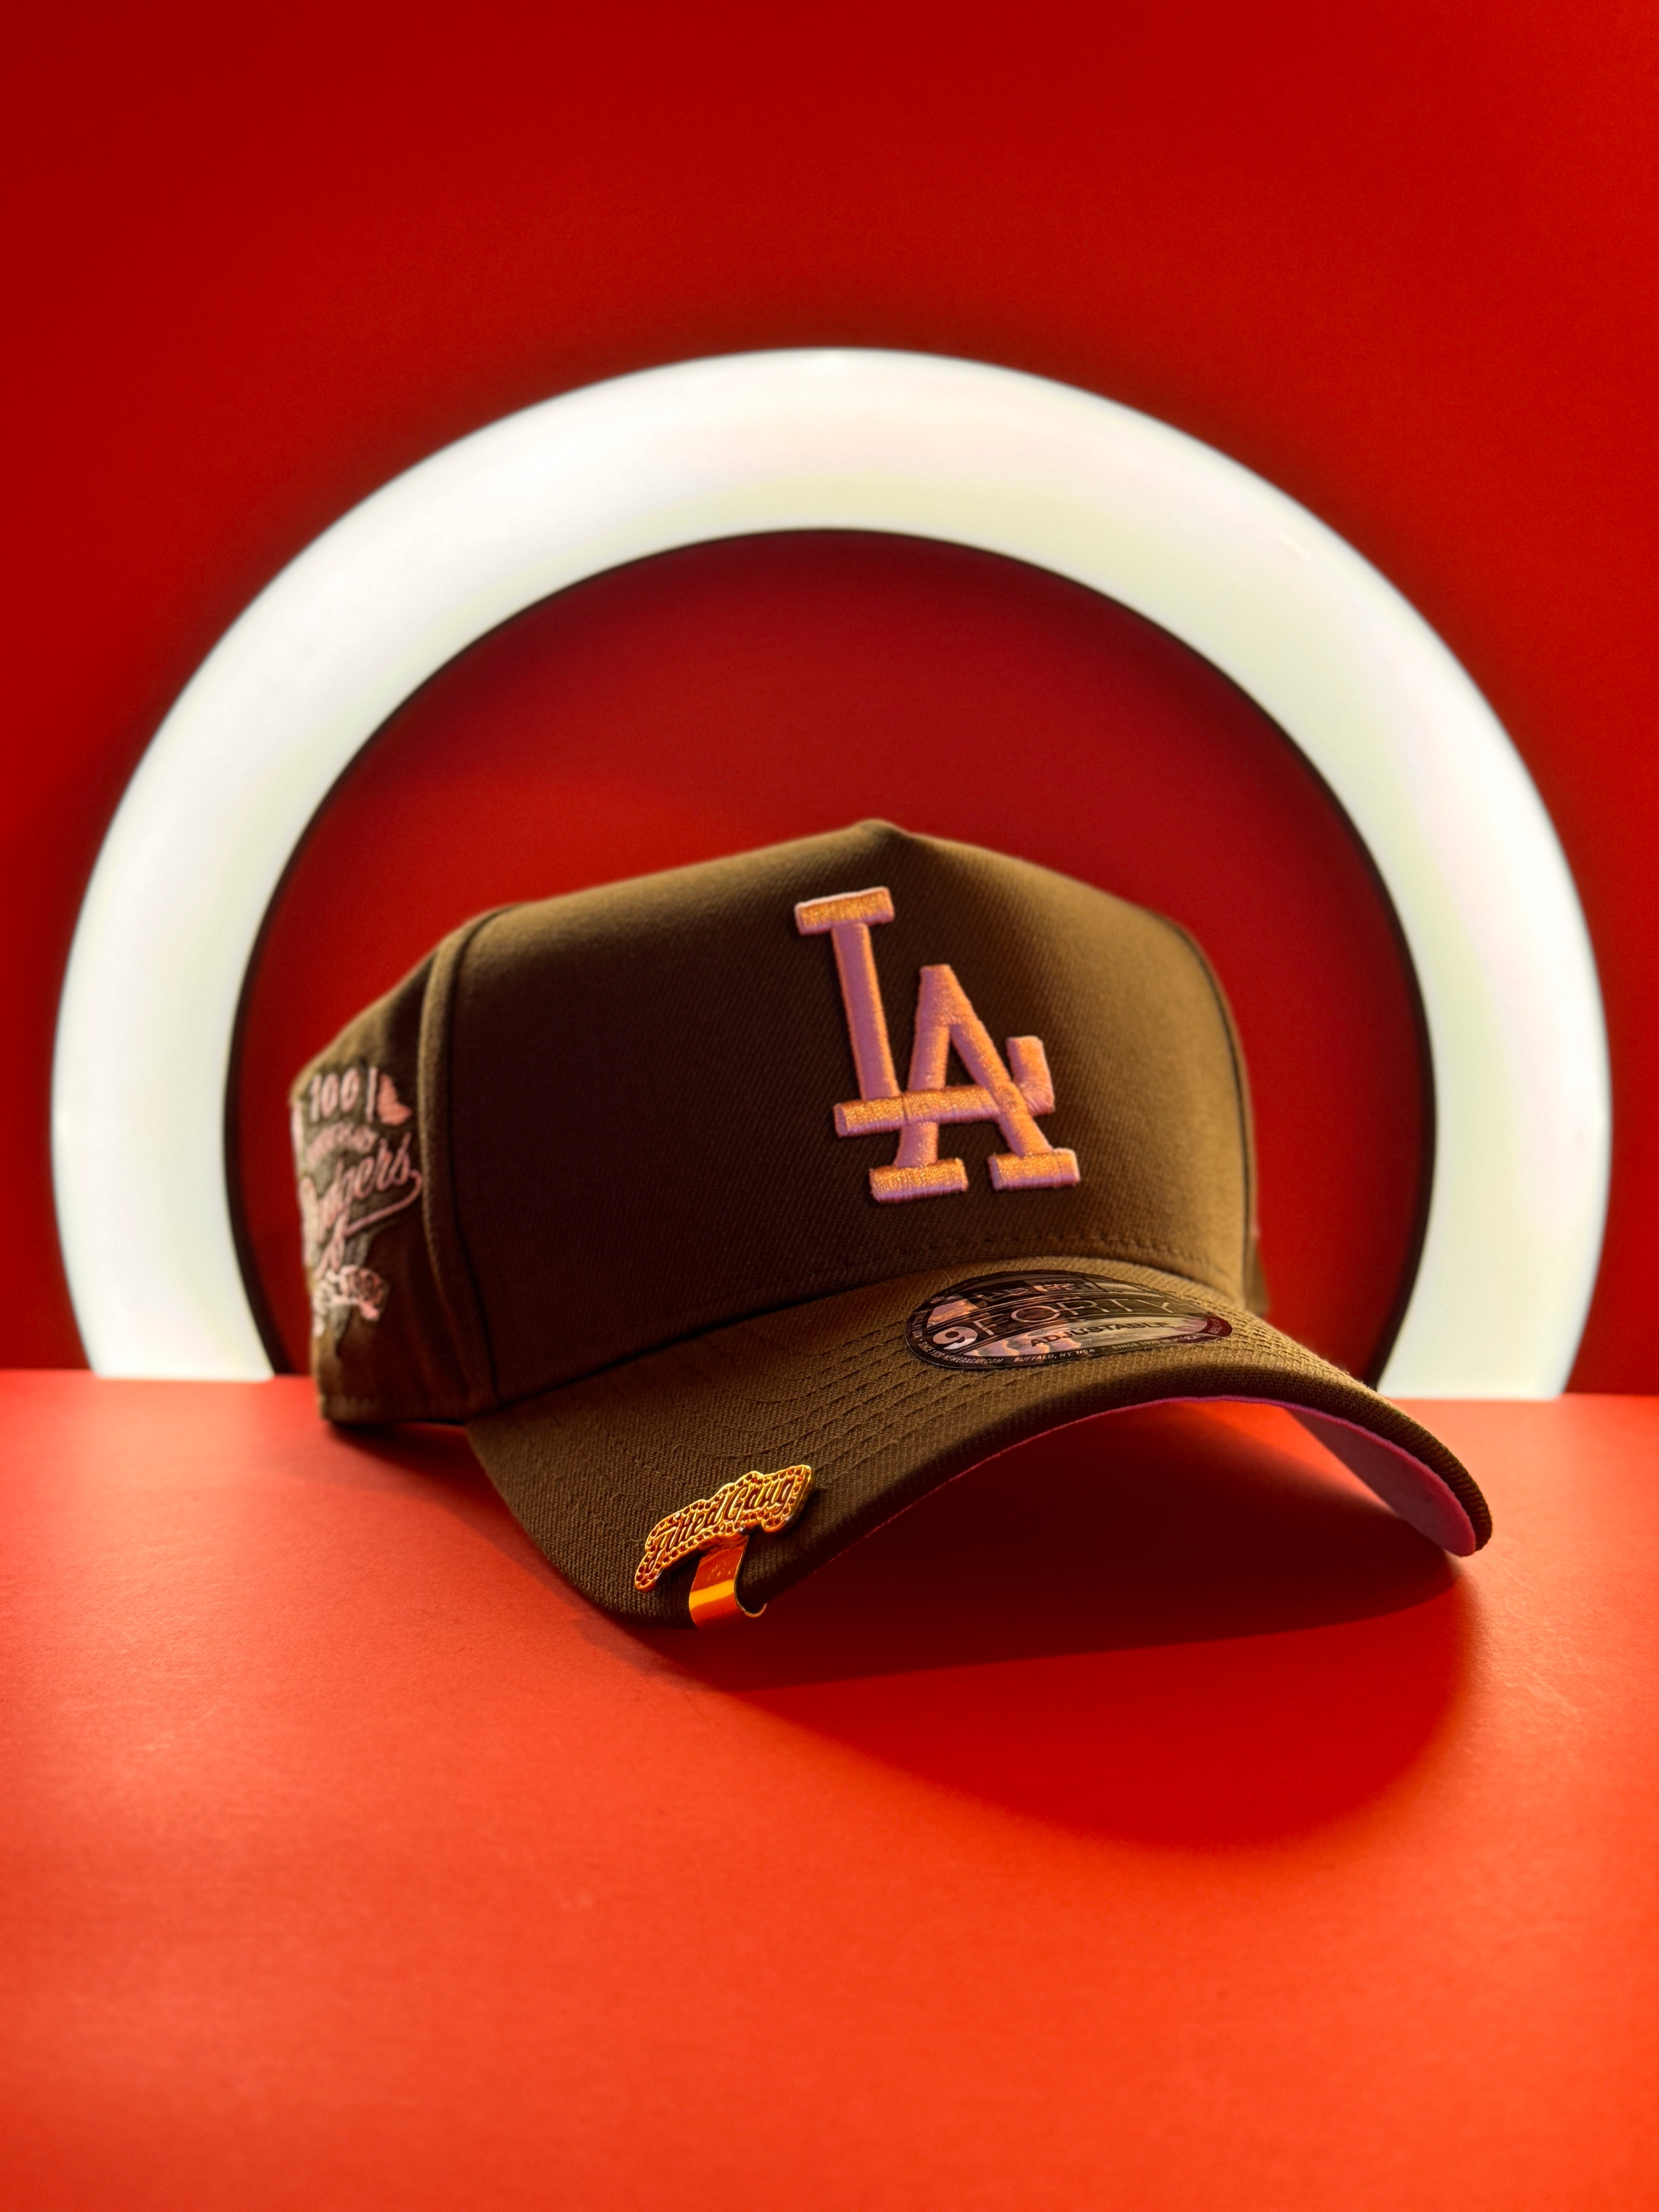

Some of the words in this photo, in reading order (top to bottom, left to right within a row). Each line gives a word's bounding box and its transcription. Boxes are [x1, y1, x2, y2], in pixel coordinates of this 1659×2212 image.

[794, 886, 1081, 1203] LA
[1030, 1322, 1175, 1347] ADJUSTABLE
[724, 1479, 795, 1522] Gang
